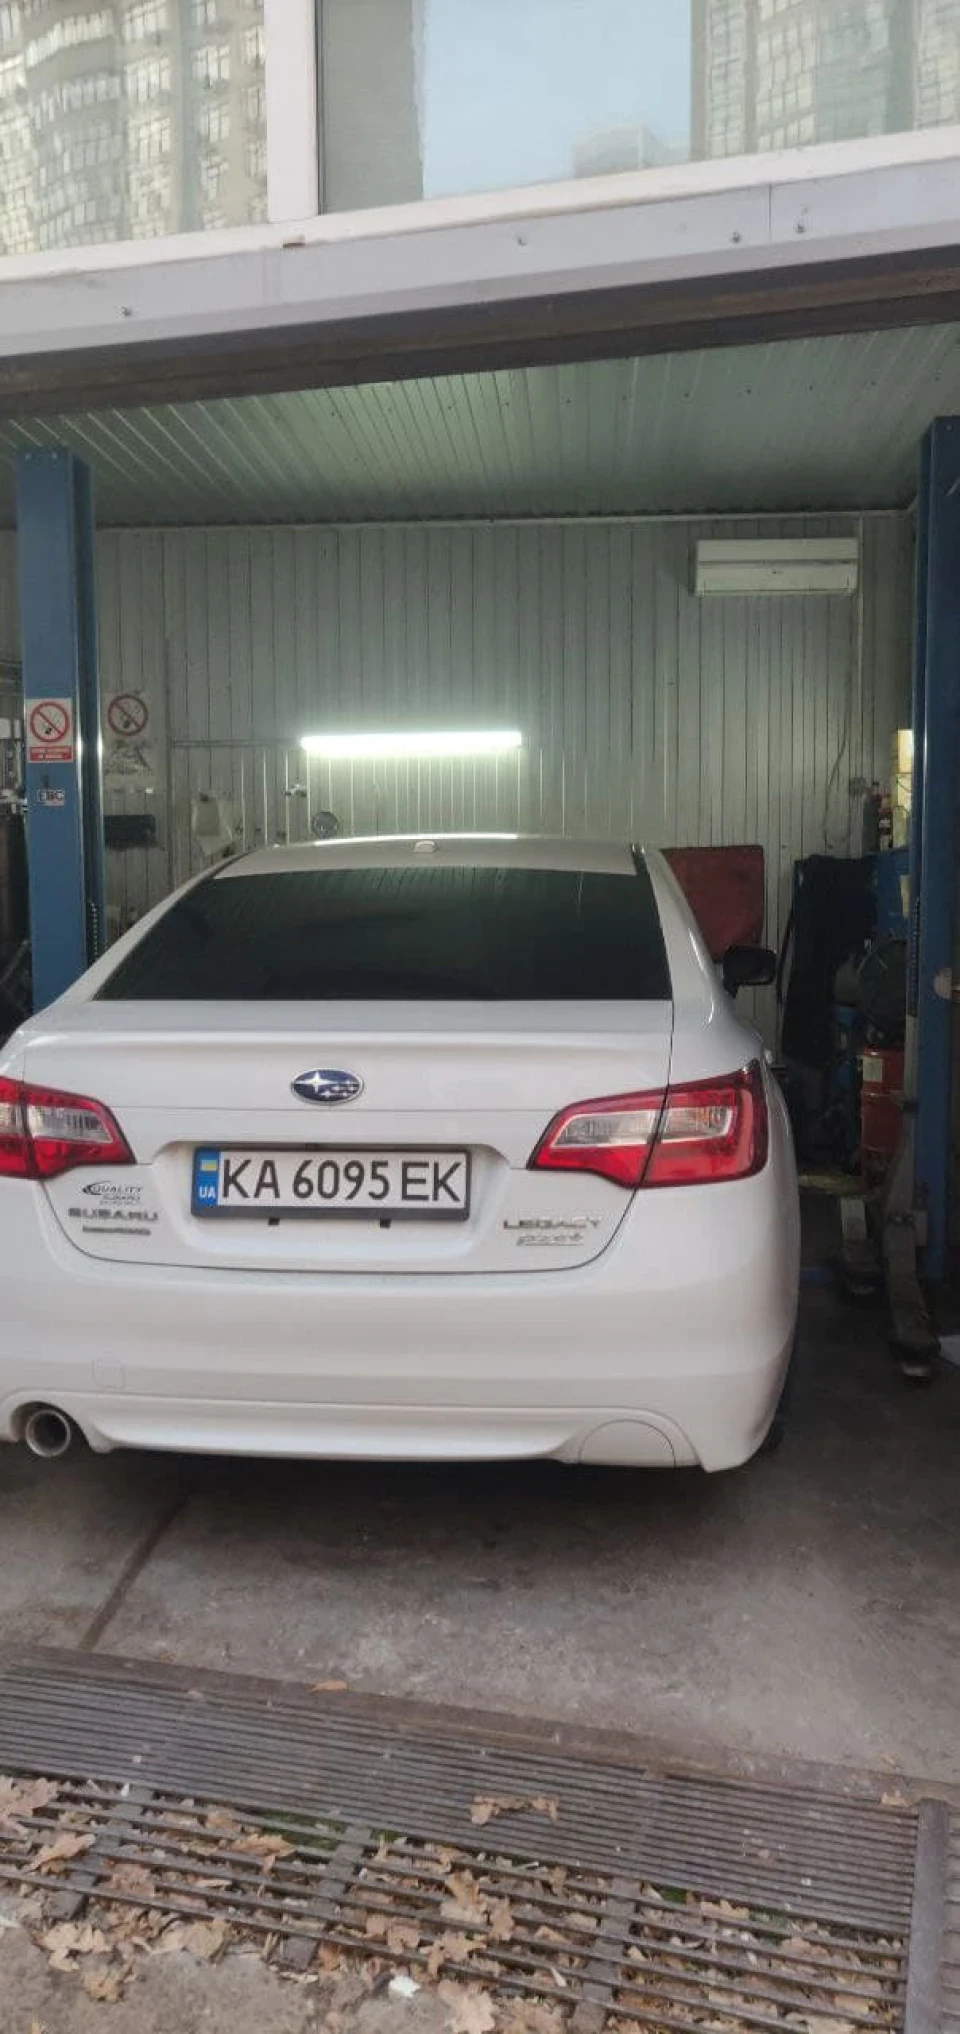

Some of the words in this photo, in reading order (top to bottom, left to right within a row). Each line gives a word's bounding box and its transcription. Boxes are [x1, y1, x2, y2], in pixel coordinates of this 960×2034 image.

[222, 1159, 280, 1200] KA
[292, 1159, 390, 1201] 6095
[401, 1161, 461, 1202] EK
[82, 1181, 143, 1195] QUALITY
[199, 1186, 216, 1200] UA
[68, 1207, 158, 1221] SUBARU
[503, 1215, 602, 1230] LEGACY
